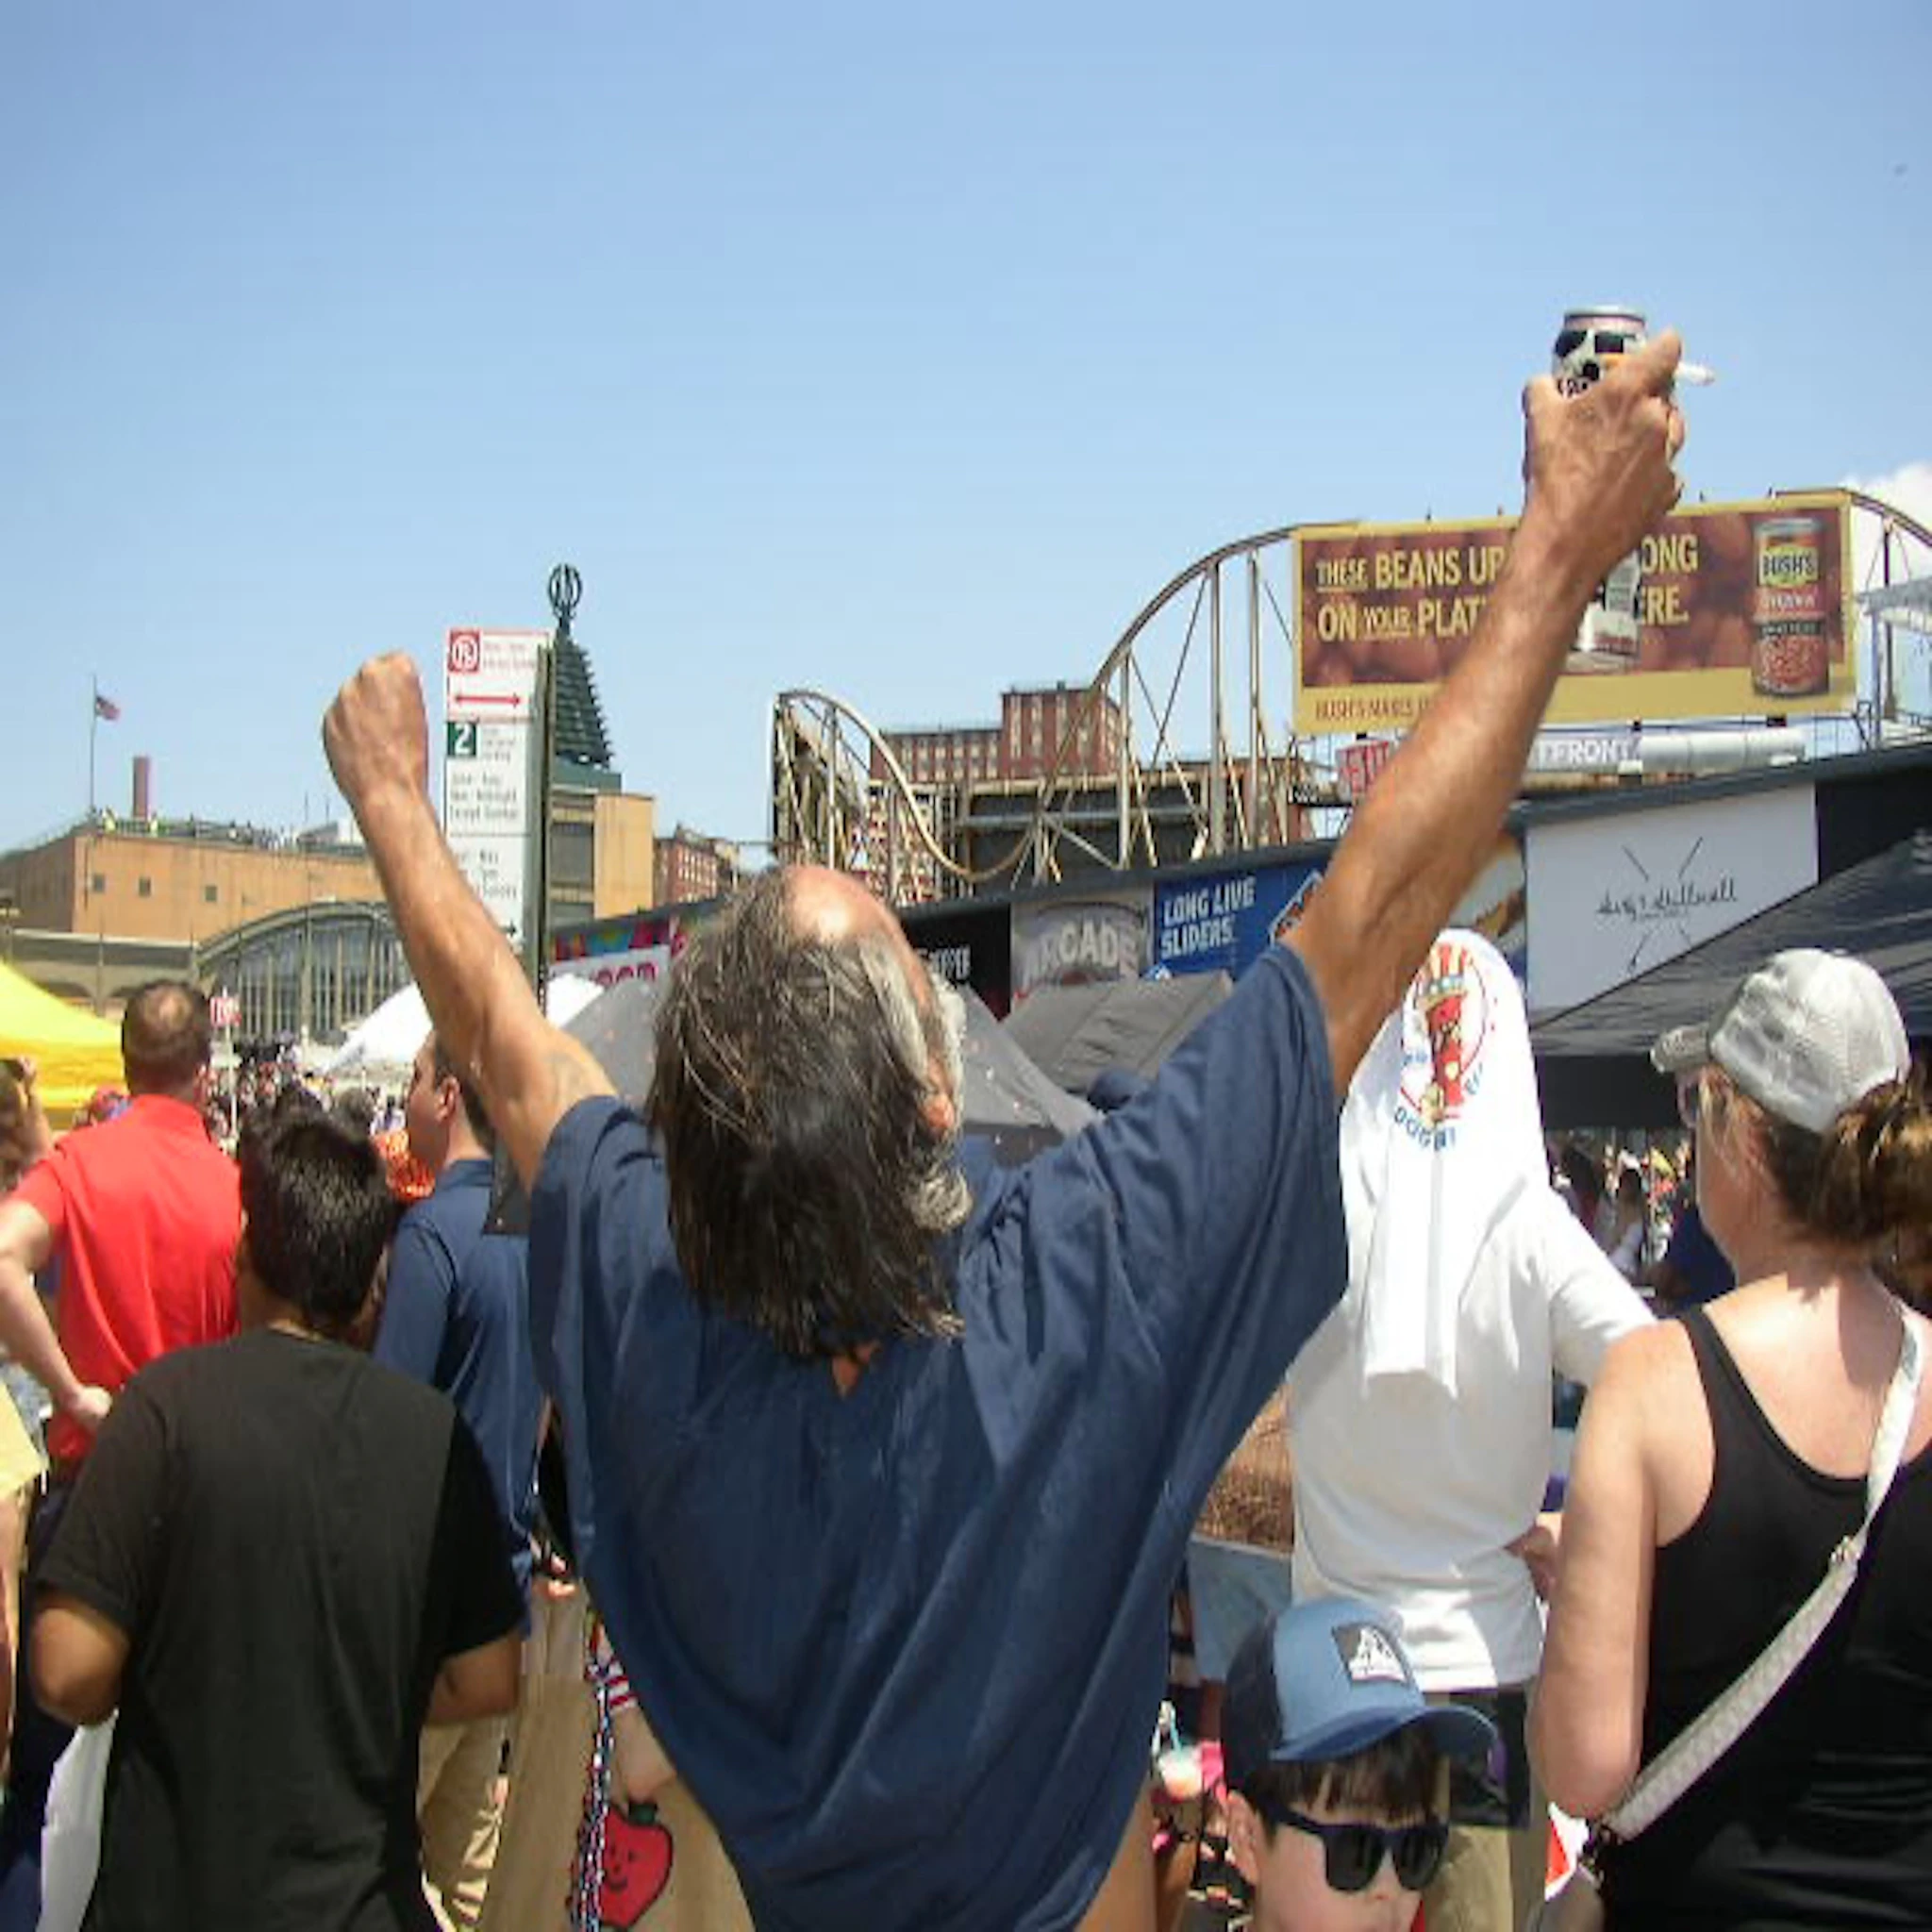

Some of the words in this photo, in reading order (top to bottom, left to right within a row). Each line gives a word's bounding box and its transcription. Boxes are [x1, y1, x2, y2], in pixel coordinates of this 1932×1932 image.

[1316, 558, 1367, 589] THESE
[1375, 547, 1462, 590] BEANS
[1640, 532, 1699, 576] ONG
[1319, 601, 1357, 642] ON
[1418, 595, 1488, 639] PLAT
[454, 723, 472, 754] 2
[1164, 887, 1209, 927] LONG
[1212, 875, 1257, 915] LIVE
